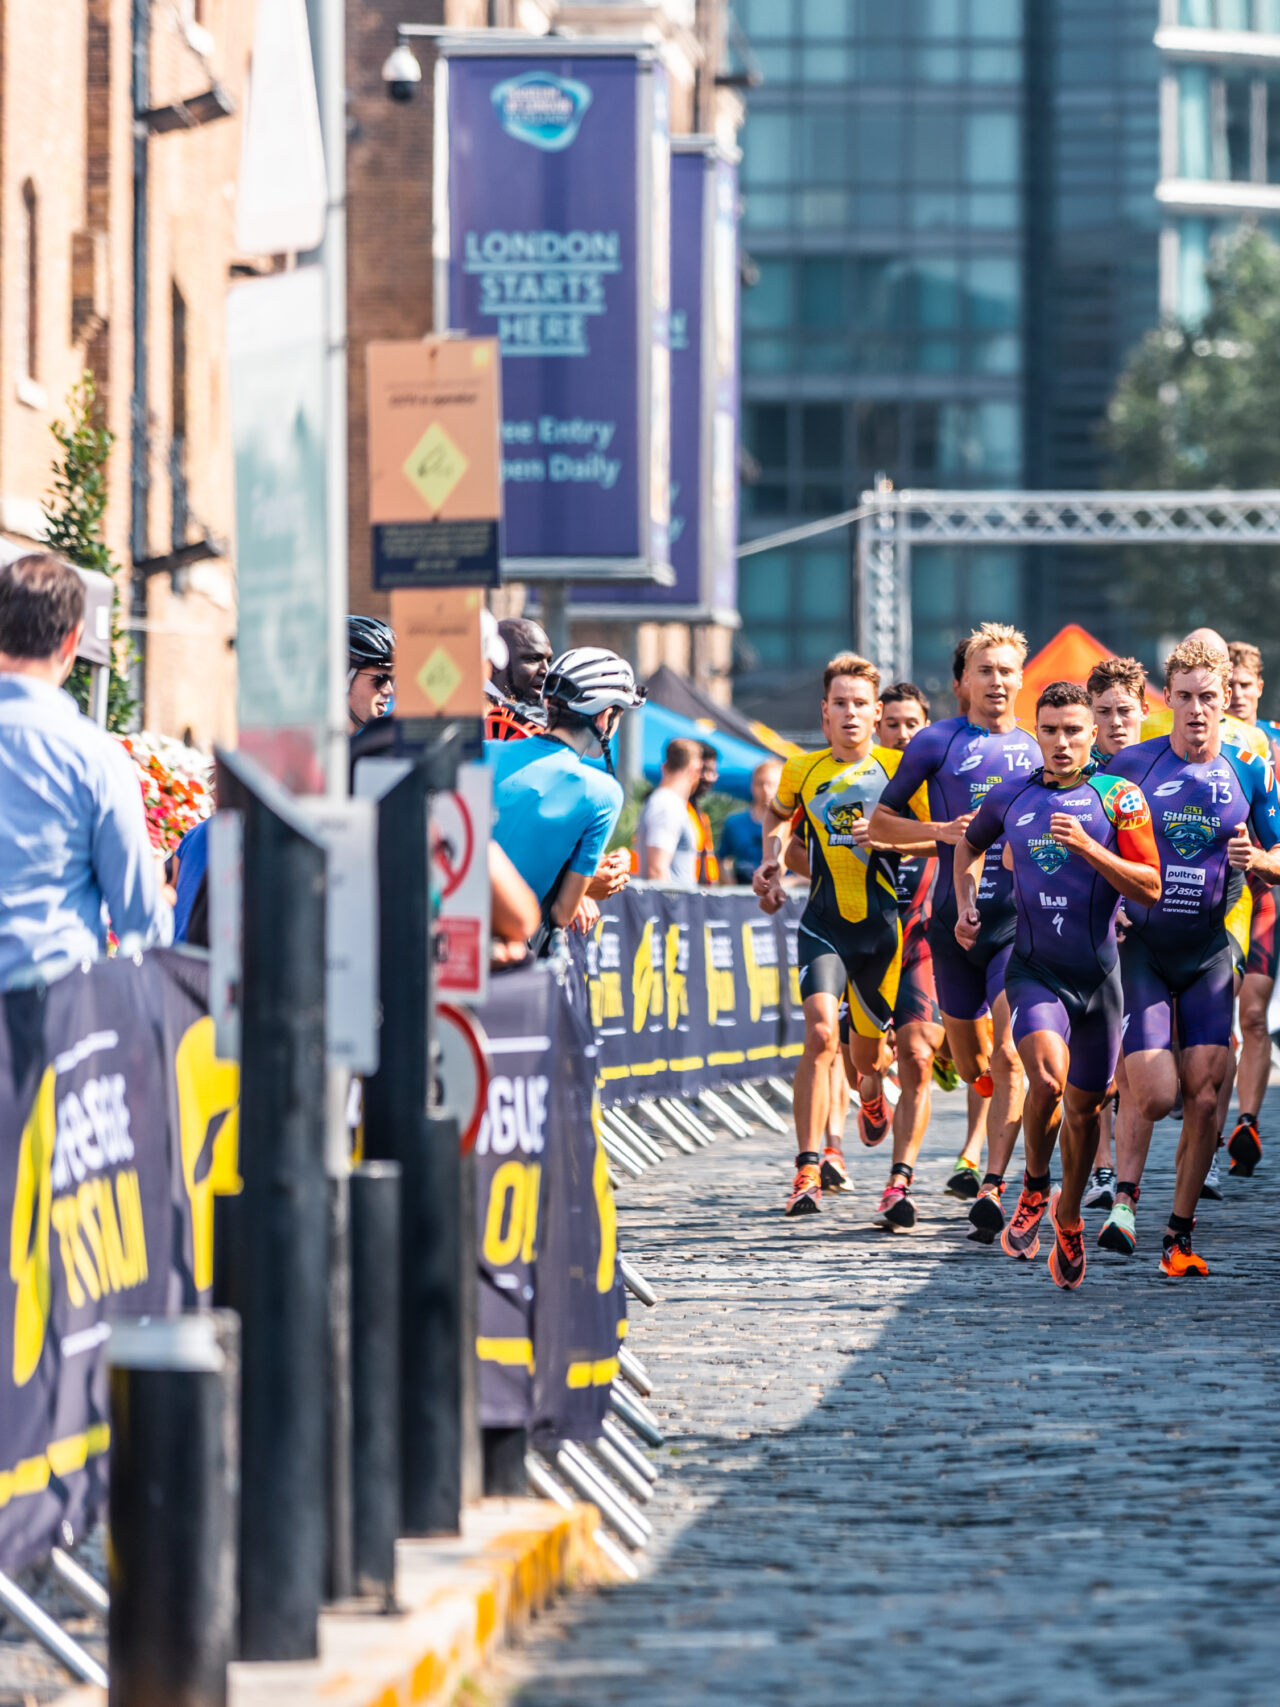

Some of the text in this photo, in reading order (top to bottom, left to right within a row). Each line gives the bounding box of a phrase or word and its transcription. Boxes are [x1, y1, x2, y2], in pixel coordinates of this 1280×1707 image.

[465, 231, 620, 262] LONDON
[481, 273, 605, 303] STARTS
[498, 315, 586, 346] HERE
[497, 415, 616, 451] ee Entry
[499, 452, 622, 490] pen Daily
[1004, 752, 1032, 772] 14
[1208, 781, 1233, 804] 13
[1162, 811, 1221, 828] SHARKS
[1184, 806, 1202, 814] SLT
[1167, 870, 1203, 881] pultron
[1177, 886, 1203, 897] asics
[1162, 907, 1199, 915] cannondale
